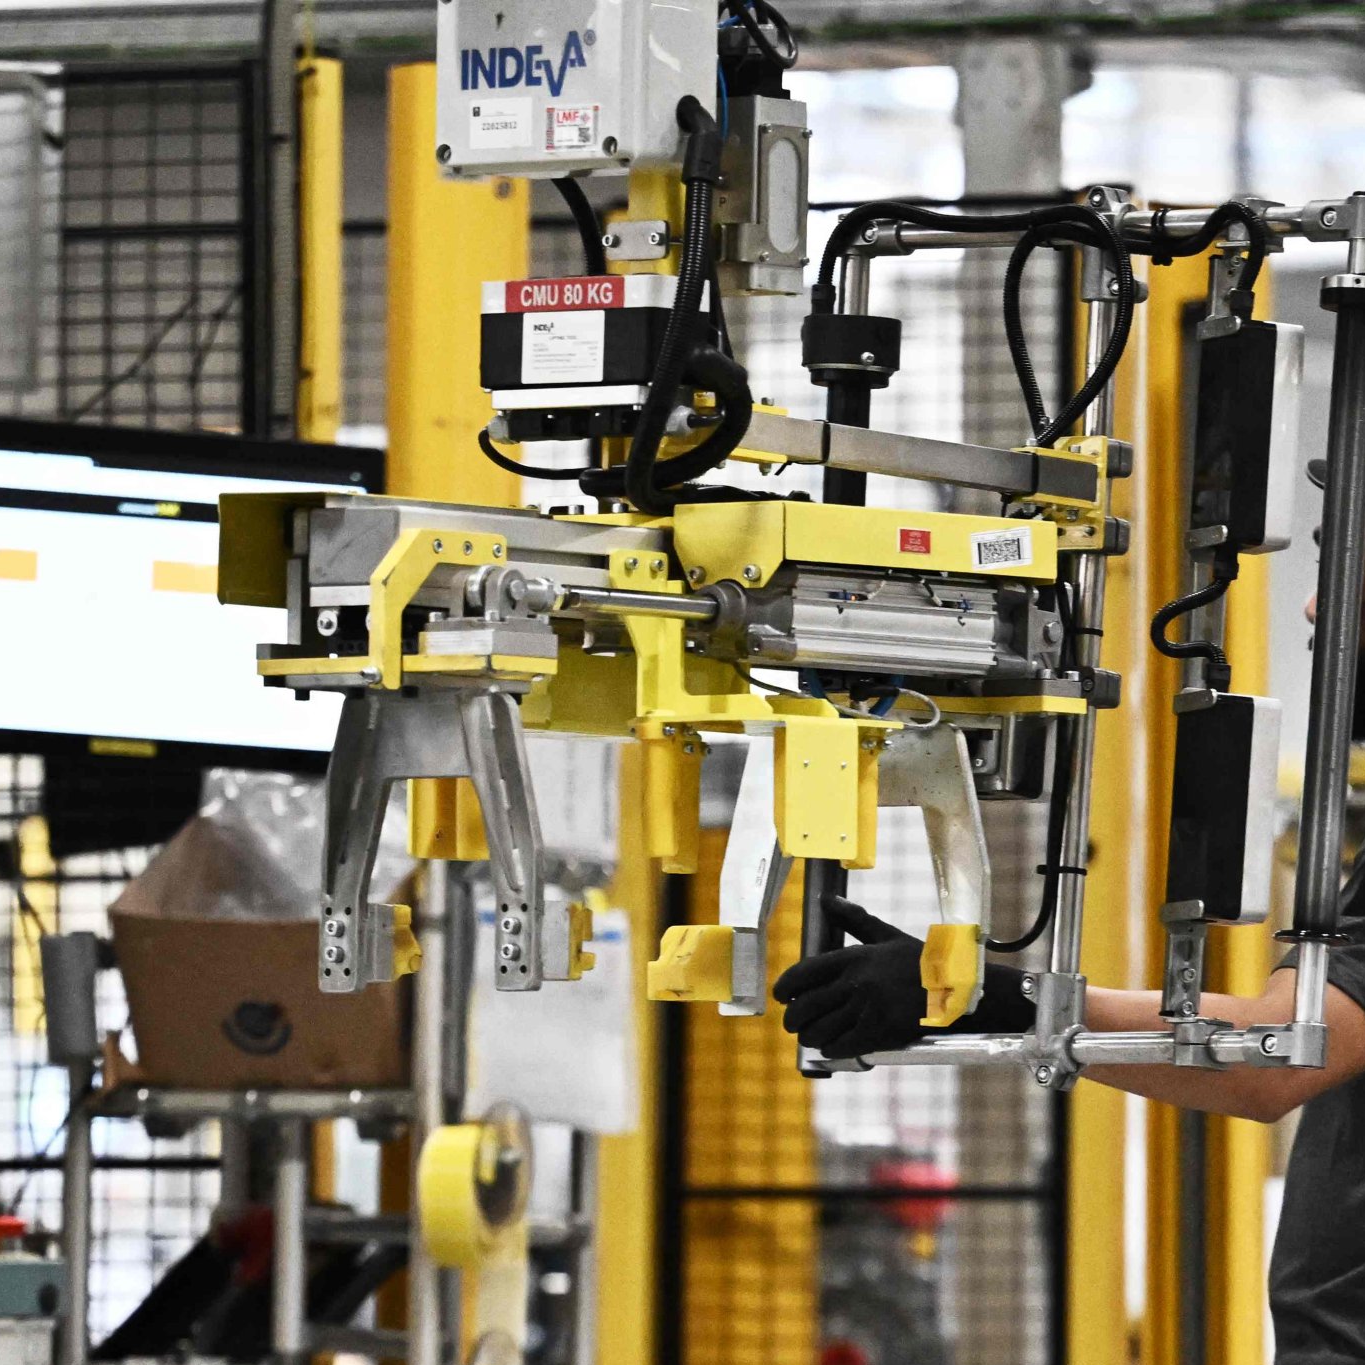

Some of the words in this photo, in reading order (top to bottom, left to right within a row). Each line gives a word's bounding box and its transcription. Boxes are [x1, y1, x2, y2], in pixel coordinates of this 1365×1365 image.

[520, 285, 559, 307] CMU
[563, 283, 583, 305] 80
[587, 282, 613, 305] KG
